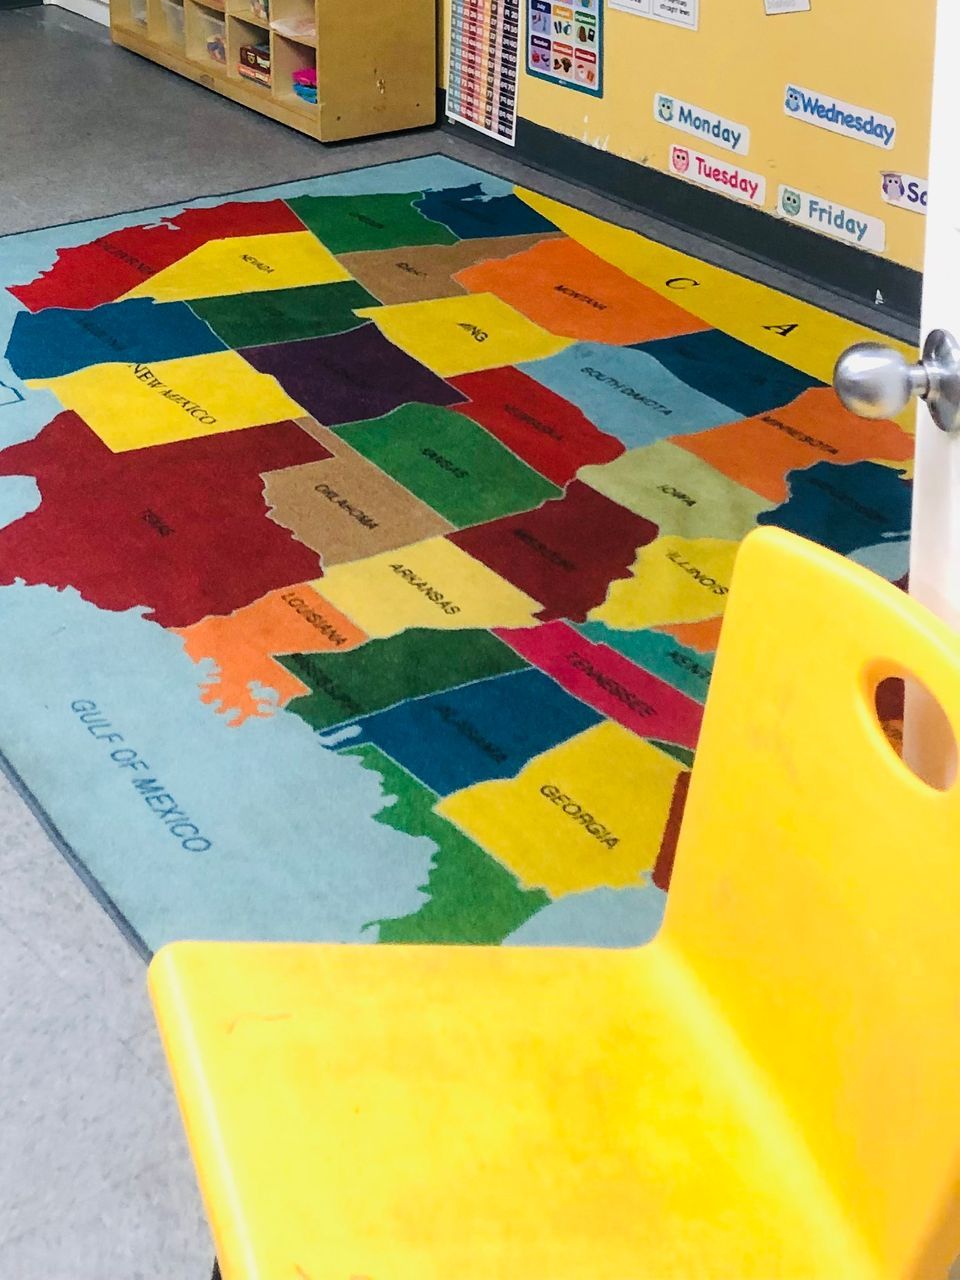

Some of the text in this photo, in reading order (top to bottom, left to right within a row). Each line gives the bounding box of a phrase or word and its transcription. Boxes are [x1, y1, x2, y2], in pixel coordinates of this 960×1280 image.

[678, 106, 742, 150] Monday
[801, 92, 895, 146] Wednesday
[695, 156, 759, 200] Tuesday
[808, 200, 868, 241] Friday
[240, 254, 275, 274] NEVADA
[554, 284, 608, 312] MONTANA
[665, 276, 799, 338] C A
[129, 363, 217, 426] NEW MEXICO
[579, 366, 674, 417] SOUTH DAKOTA
[314, 483, 380, 532] OKLAHOMA
[389, 562, 462, 617] ARKANSAS
[664, 548, 729, 596] ILLINOIS
[281, 592, 348, 646] LOUISIANA
[70, 698, 212, 852] GULF OF MEXICO
[540, 784, 621, 850] GEORGIA
